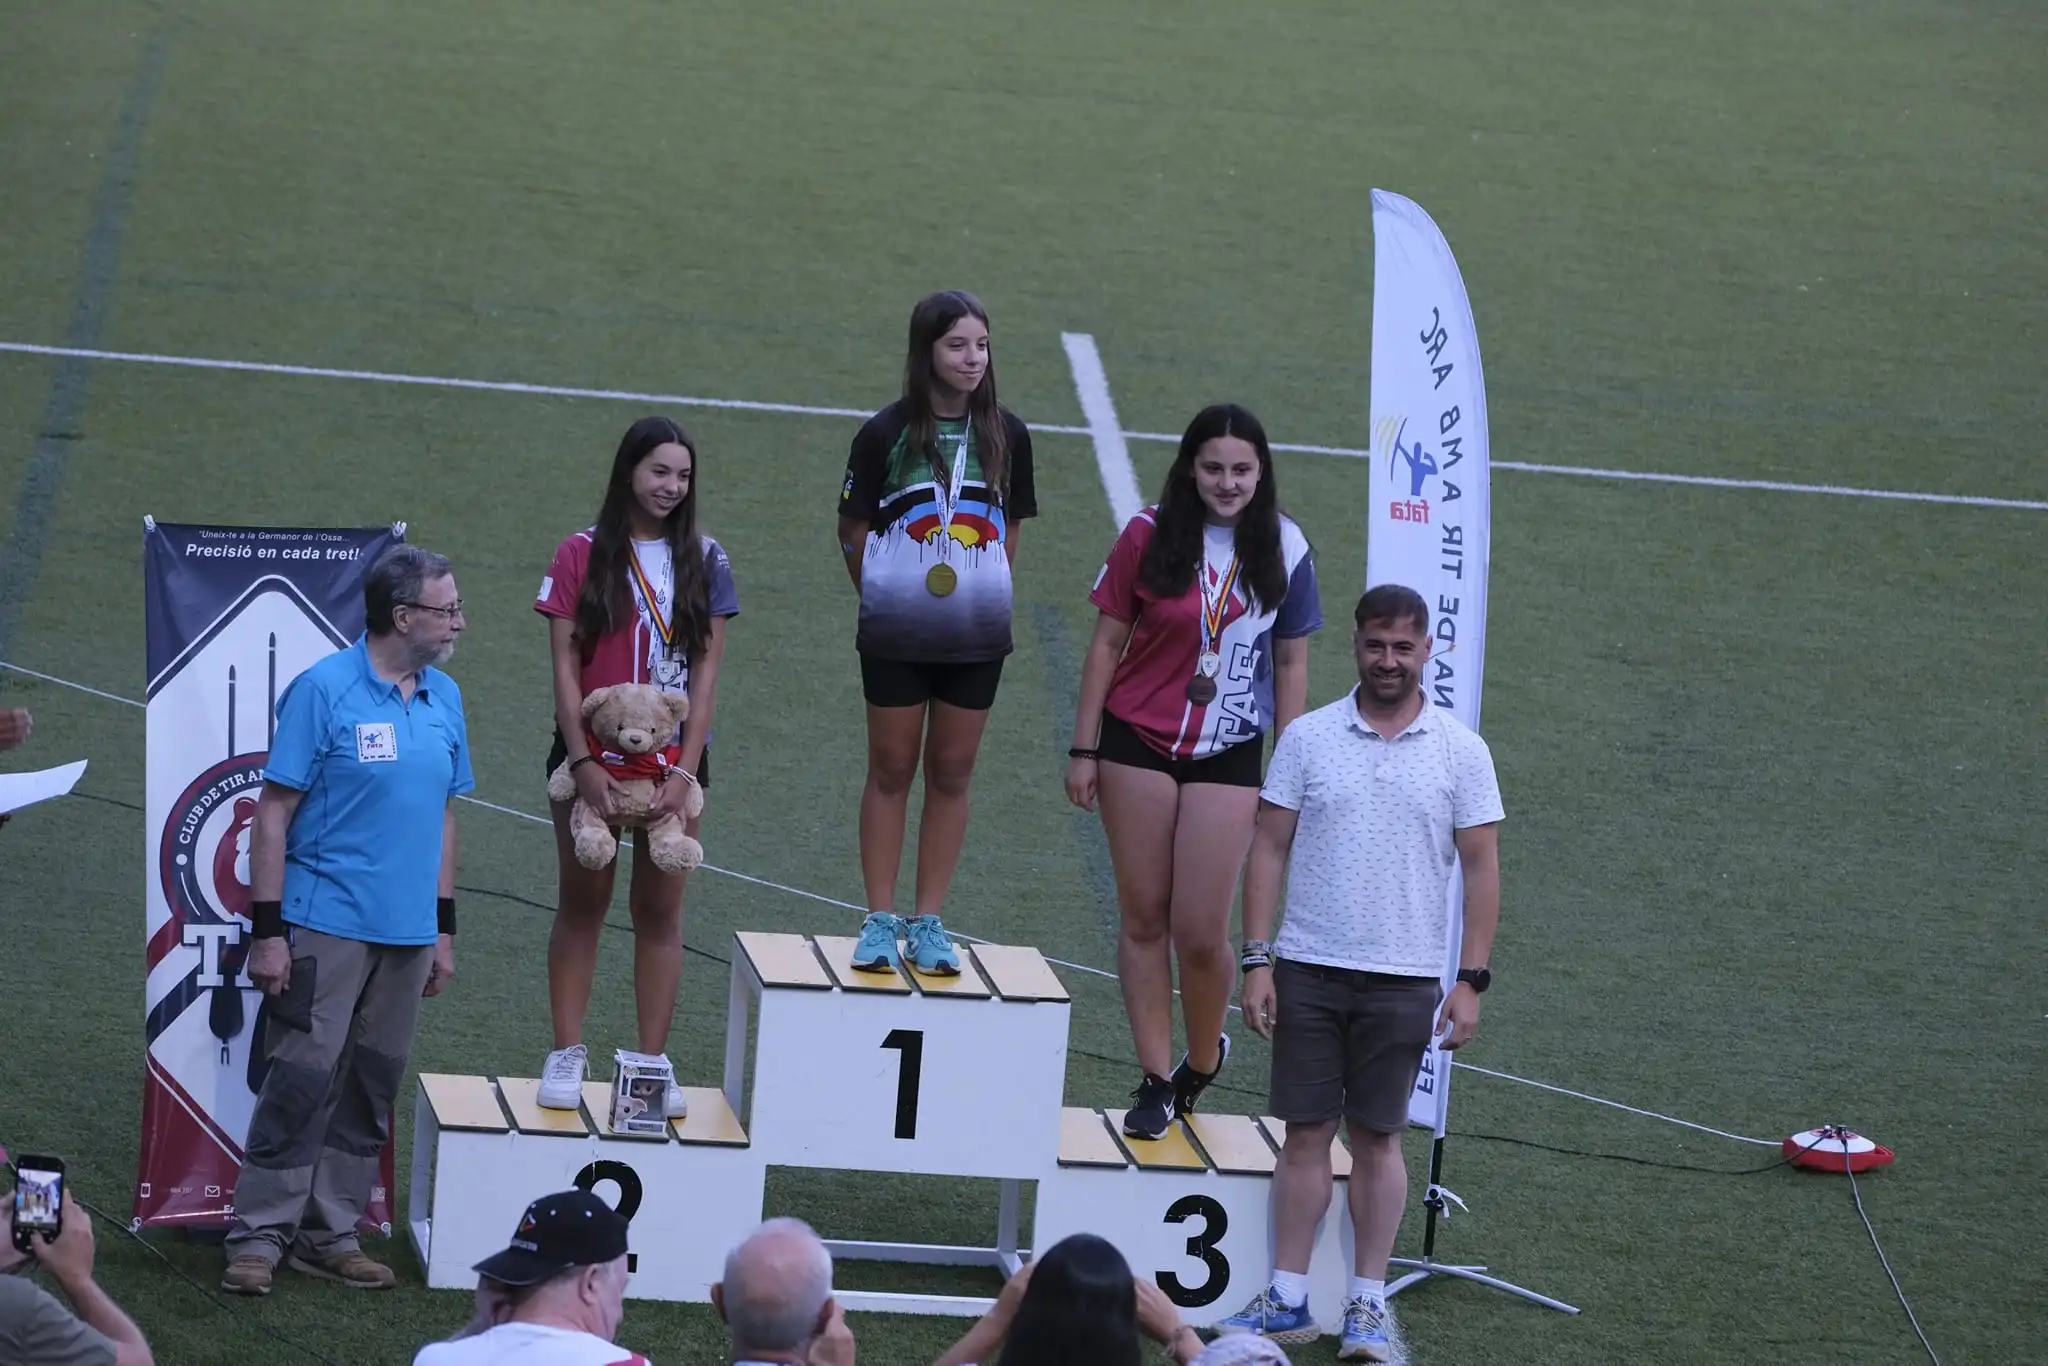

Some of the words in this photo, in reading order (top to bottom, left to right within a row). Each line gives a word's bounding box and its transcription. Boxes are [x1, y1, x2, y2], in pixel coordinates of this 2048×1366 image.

[185, 543, 252, 558] Precisió
[257, 548, 276, 559] en
[282, 546, 321, 560] cada
[257, 532, 301, 541] Germanor
[302, 533, 314, 541] de
[179, 805, 205, 844] CLUB
[200, 787, 221, 808] DE
[218, 773, 246, 792] TIR
[880, 1029, 923, 1139] 1
[1155, 1194, 1231, 1308] 3
